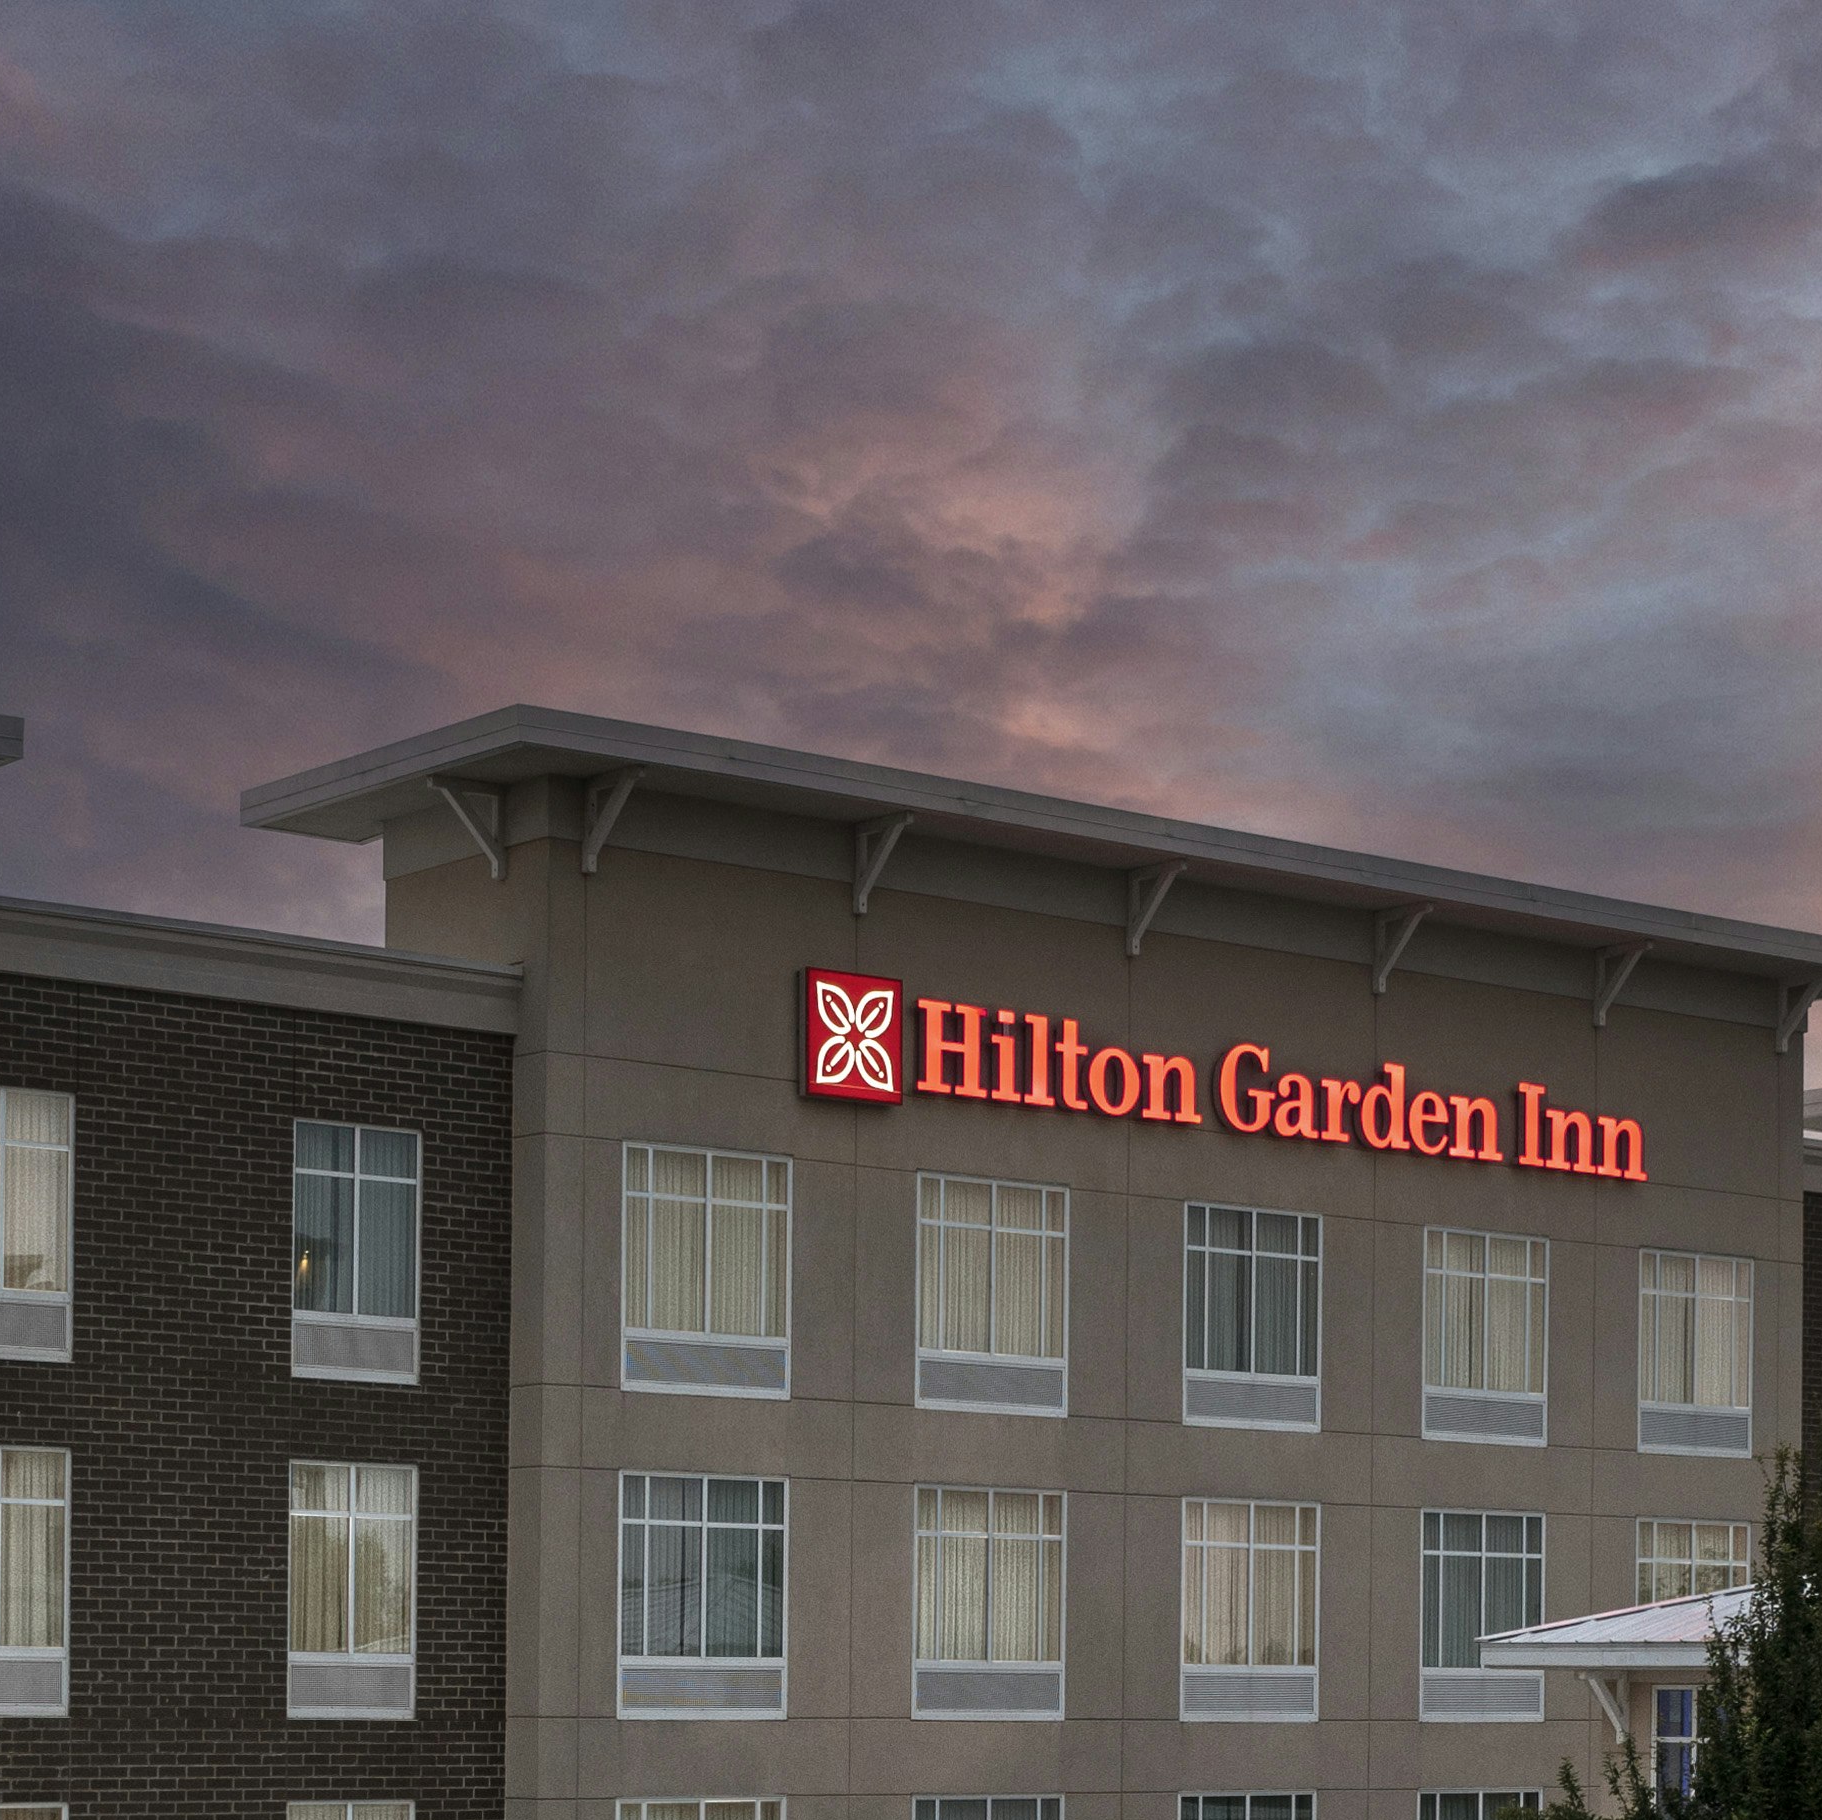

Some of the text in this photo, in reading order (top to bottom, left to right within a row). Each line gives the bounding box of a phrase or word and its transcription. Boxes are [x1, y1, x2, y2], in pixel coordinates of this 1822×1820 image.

[917, 998, 1648, 1182] Hilton Garden Inn
